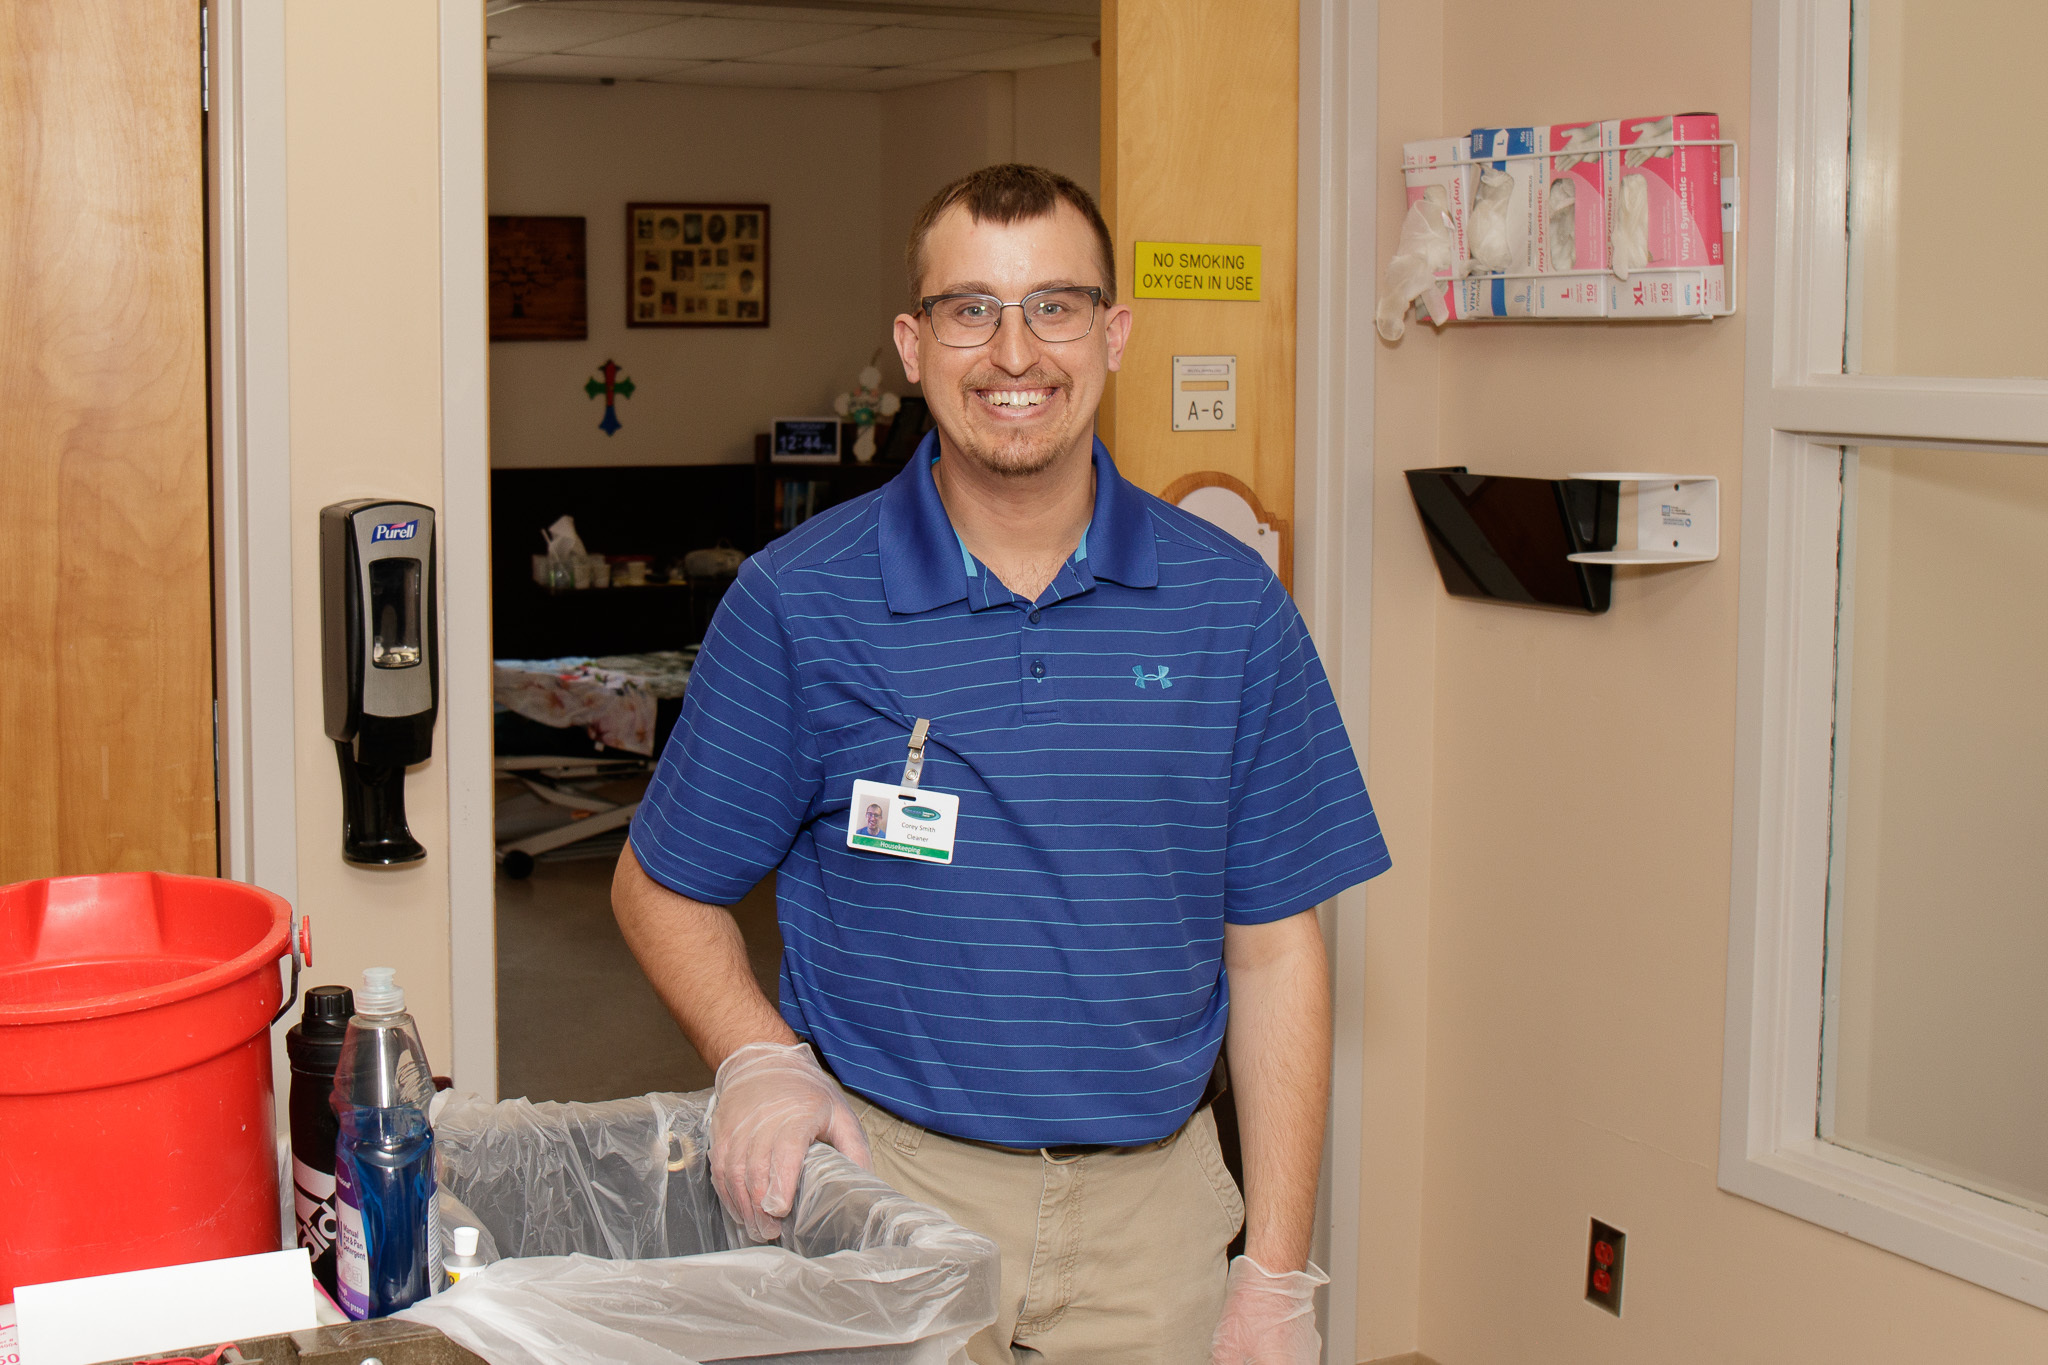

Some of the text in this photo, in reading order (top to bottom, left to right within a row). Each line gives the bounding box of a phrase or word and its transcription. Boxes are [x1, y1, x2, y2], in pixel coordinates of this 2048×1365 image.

[1453, 178, 1462, 205] Vinyl
[1679, 176, 1689, 230] Synthetic
[1455, 208, 1465, 260] Synthetic
[1681, 232, 1690, 260] Vinyl
[1153, 252, 1245, 270] NO SMOKING
[1143, 274, 1254, 290] OXYGEN IN USE
[1561, 288, 1569, 298] L
[1586, 284, 1594, 302] 150
[1633, 281, 1644, 306] XL
[1188, 400, 1224, 420] A-6
[779, 436, 821, 450] 12:44
[376, 524, 414, 539] Purell
[901, 822, 918, 830] Corey
[906, 834, 928, 842] Cleaner
[880, 841, 920, 855] Housekeeping
[343, 1223, 359, 1239] Manual
[343, 1242, 366, 1260] Detergent
[354, 1239, 364, 1250] Pan
[350, 1303, 365, 1316] grease
